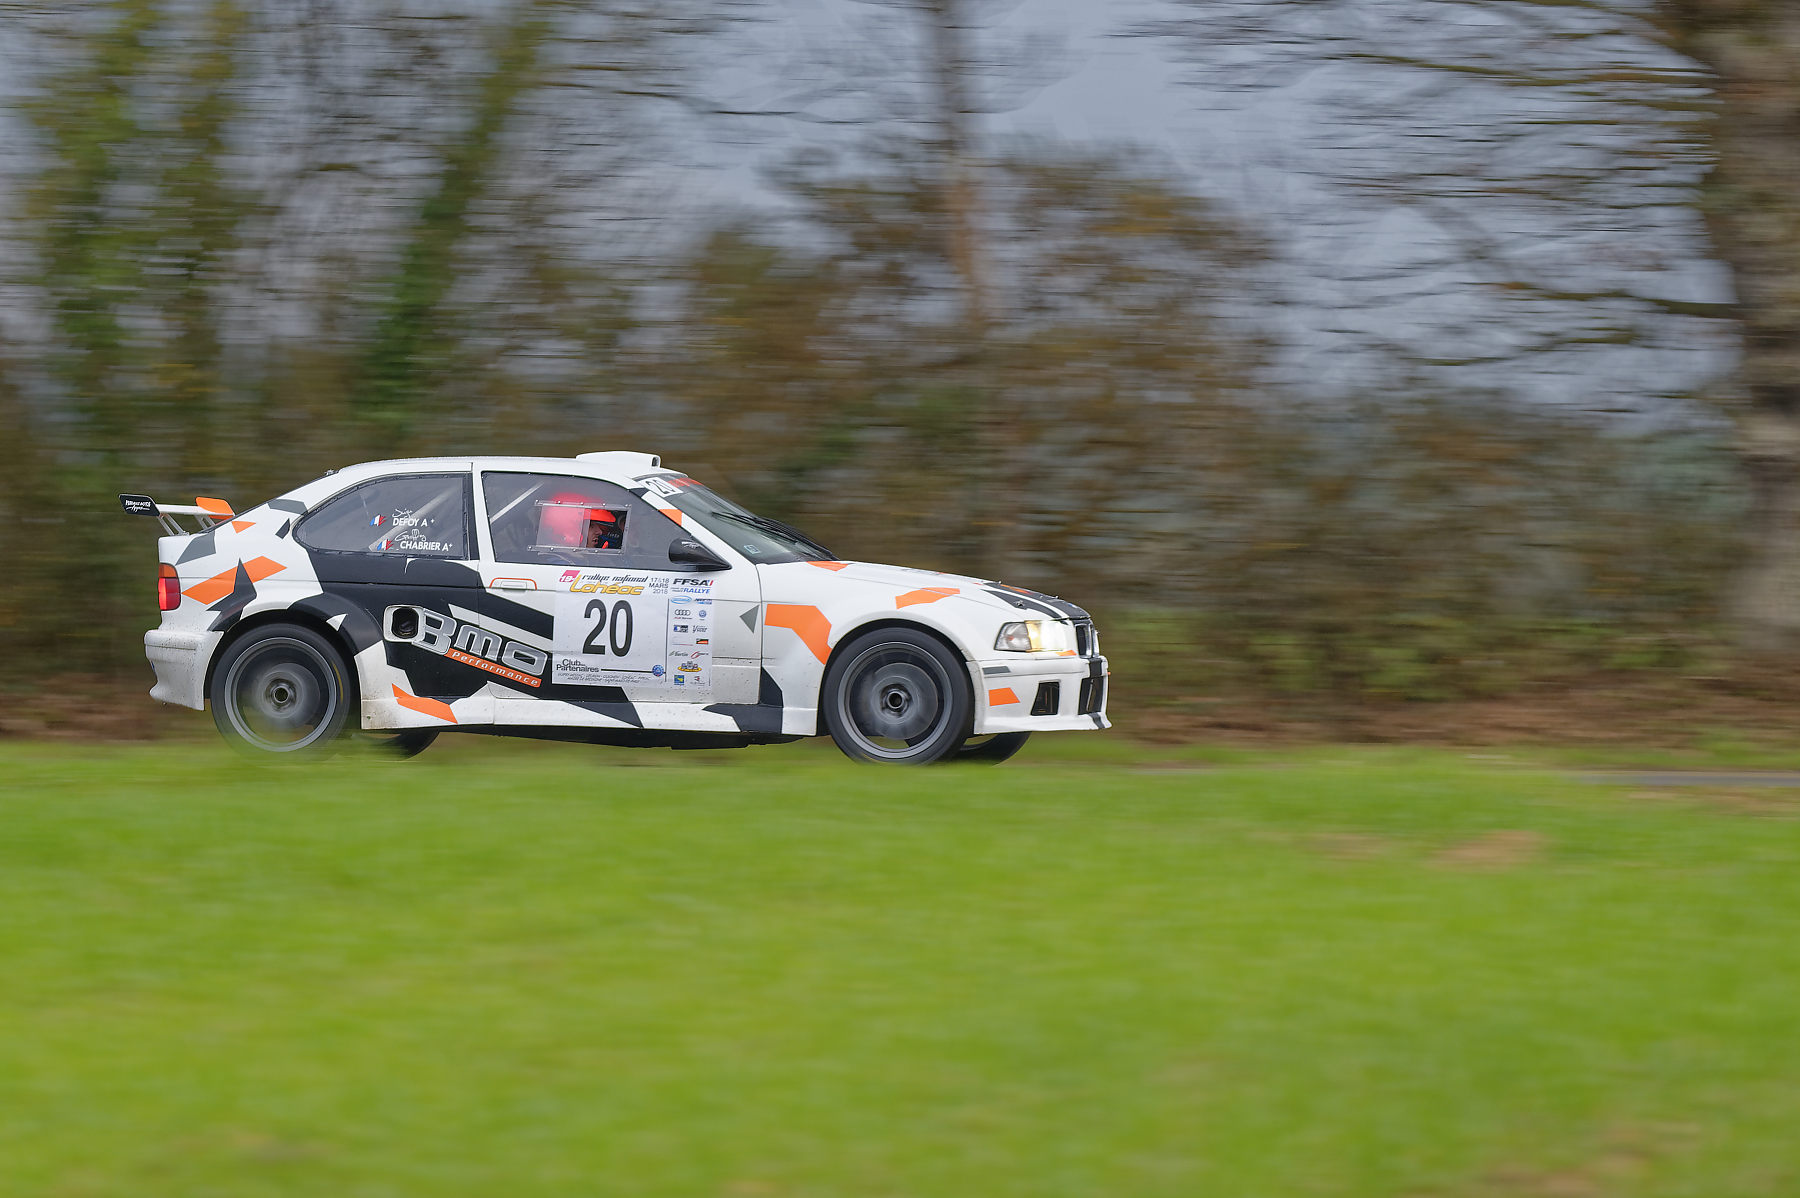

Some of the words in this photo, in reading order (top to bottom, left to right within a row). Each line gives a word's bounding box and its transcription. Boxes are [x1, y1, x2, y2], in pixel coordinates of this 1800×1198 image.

[645, 479, 677, 495] 20
[392, 518, 419, 527] DEFOY
[400, 541, 440, 551] CHABRIER
[582, 573, 610, 582] rallye
[612, 575, 649, 584] national
[672, 578, 709, 586] FFSA
[570, 574, 645, 595] Lohéac
[582, 598, 633, 657] 20
[562, 658, 581, 666] Club
[451, 650, 539, 687] Performance
[556, 663, 600, 673] Partenaires
